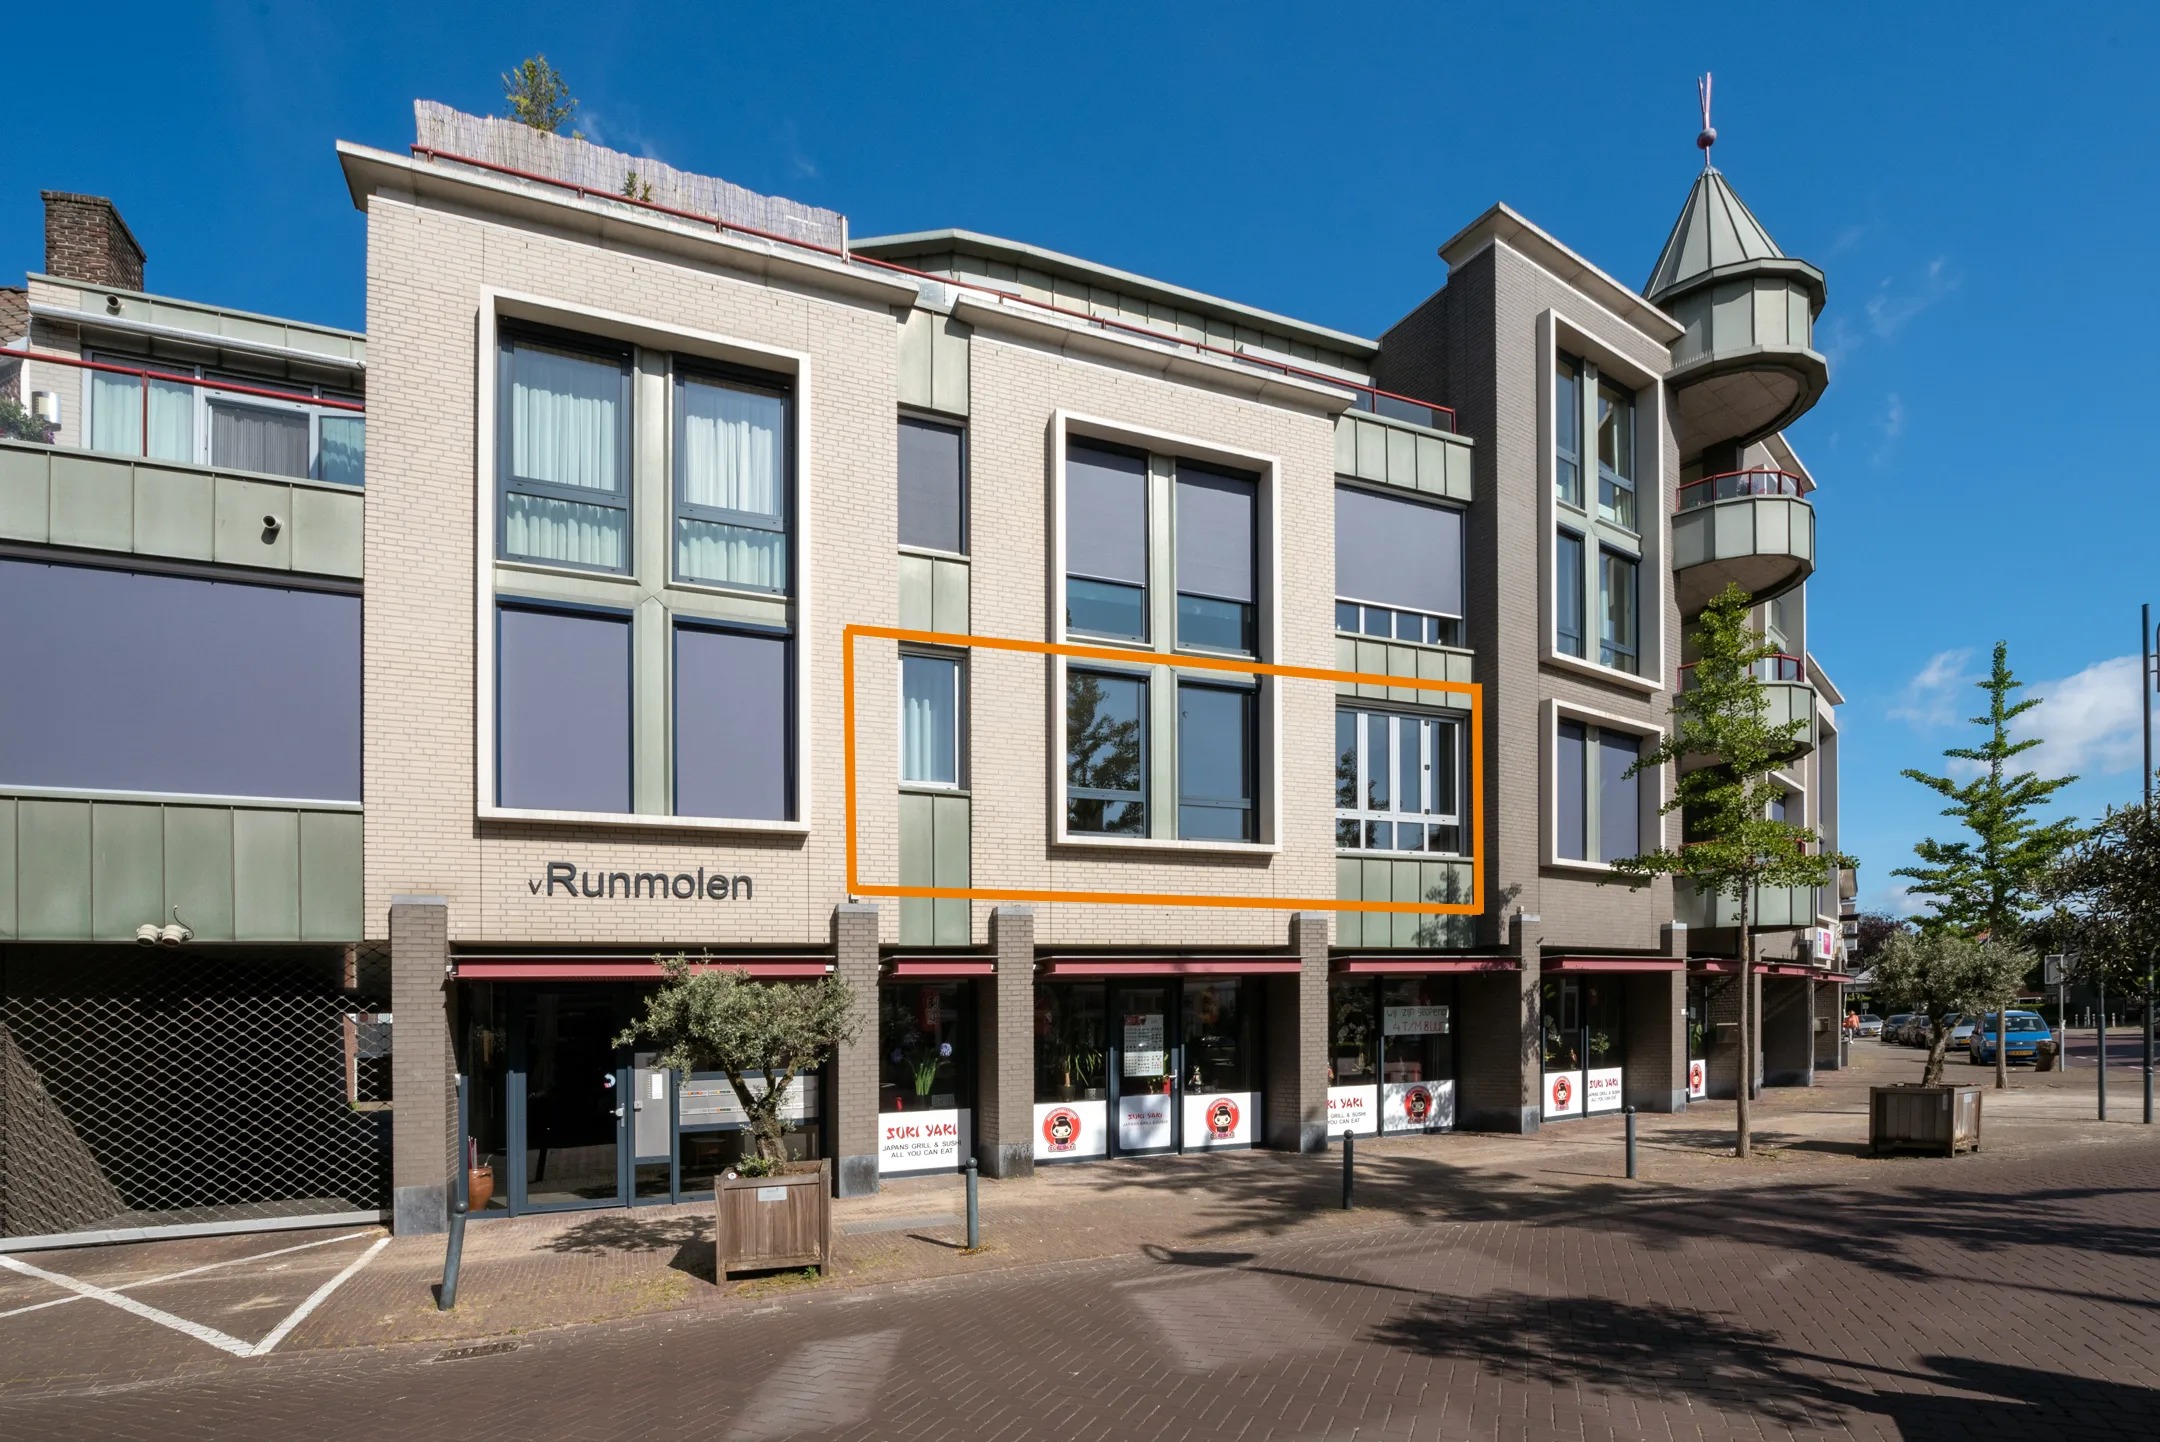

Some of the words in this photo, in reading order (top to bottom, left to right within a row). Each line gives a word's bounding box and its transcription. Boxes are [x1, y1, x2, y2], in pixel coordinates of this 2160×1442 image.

[547, 861, 753, 900] Runmolen
[1589, 1079, 1604, 1089] SUKI
[1340, 1097, 1363, 1109] YAKI
[886, 1125, 920, 1140] SUKI
[925, 1123, 958, 1137] YAKI
[882, 1143, 909, 1152] JAPANS
[911, 1142, 931, 1150] GRILL
